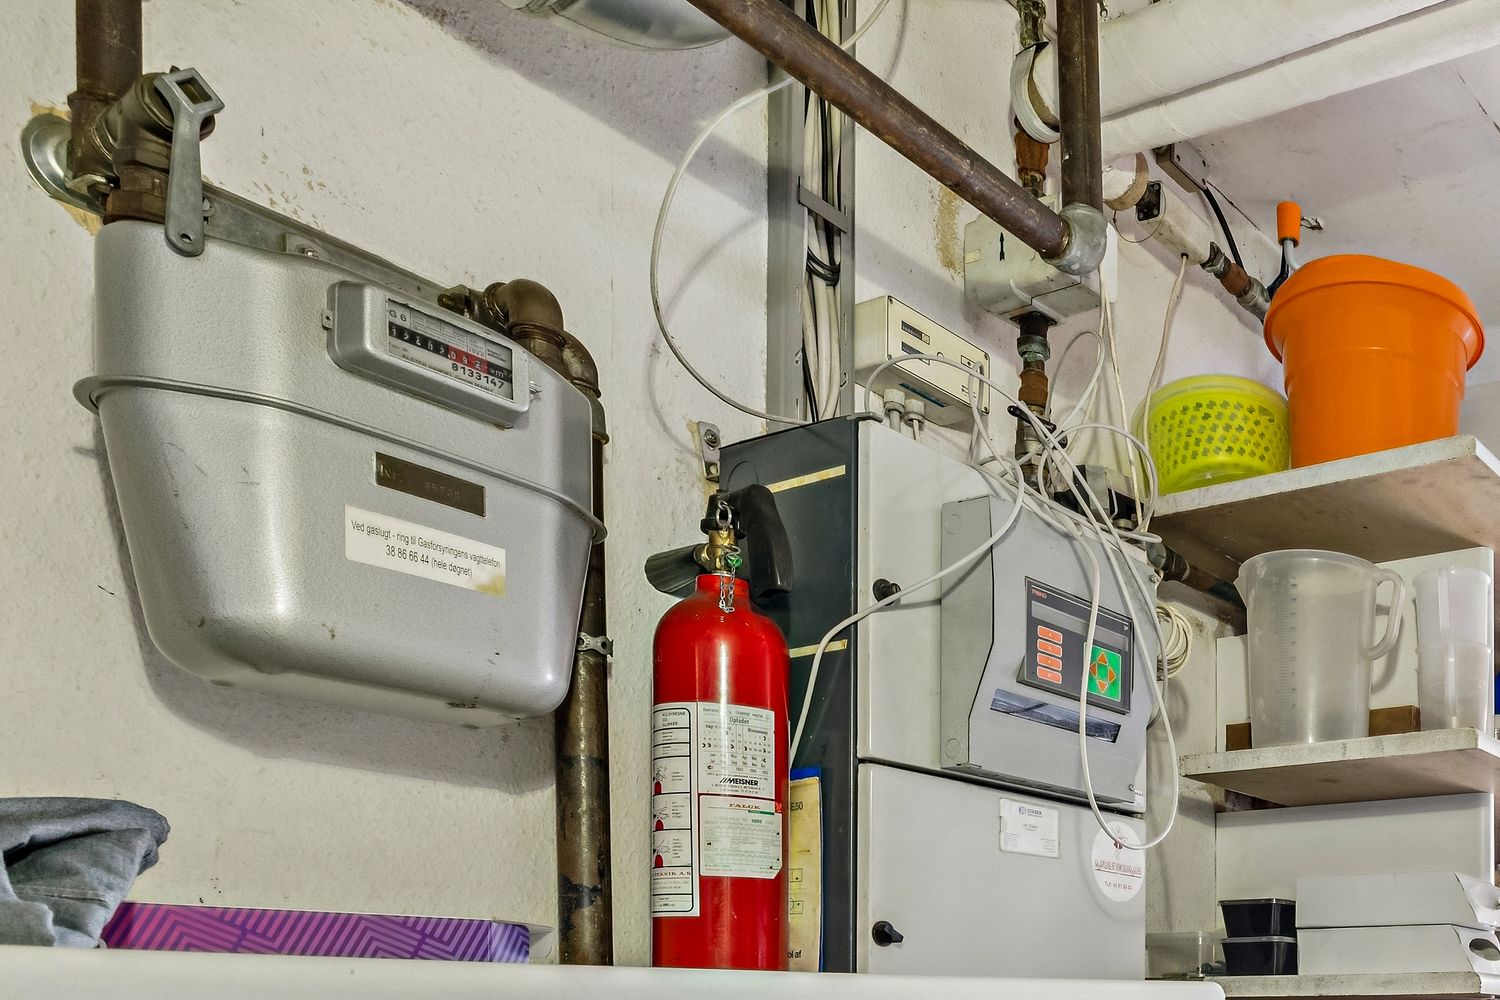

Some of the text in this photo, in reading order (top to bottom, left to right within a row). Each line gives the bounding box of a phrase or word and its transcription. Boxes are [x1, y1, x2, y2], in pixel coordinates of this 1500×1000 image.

[389, 309, 397, 318] G
[452, 362, 504, 389] 8133147
[351, 519, 365, 532] Ved
[366, 525, 392, 541] gaslugt
[397, 532, 409, 546] ring
[417, 537, 469, 560] Gasforsyningens
[469, 552, 501, 569] vagttelefon
[386, 544, 473, 579] 38 86 66 44 (hele døgnet)
[727, 777, 759, 786] MEISNER
